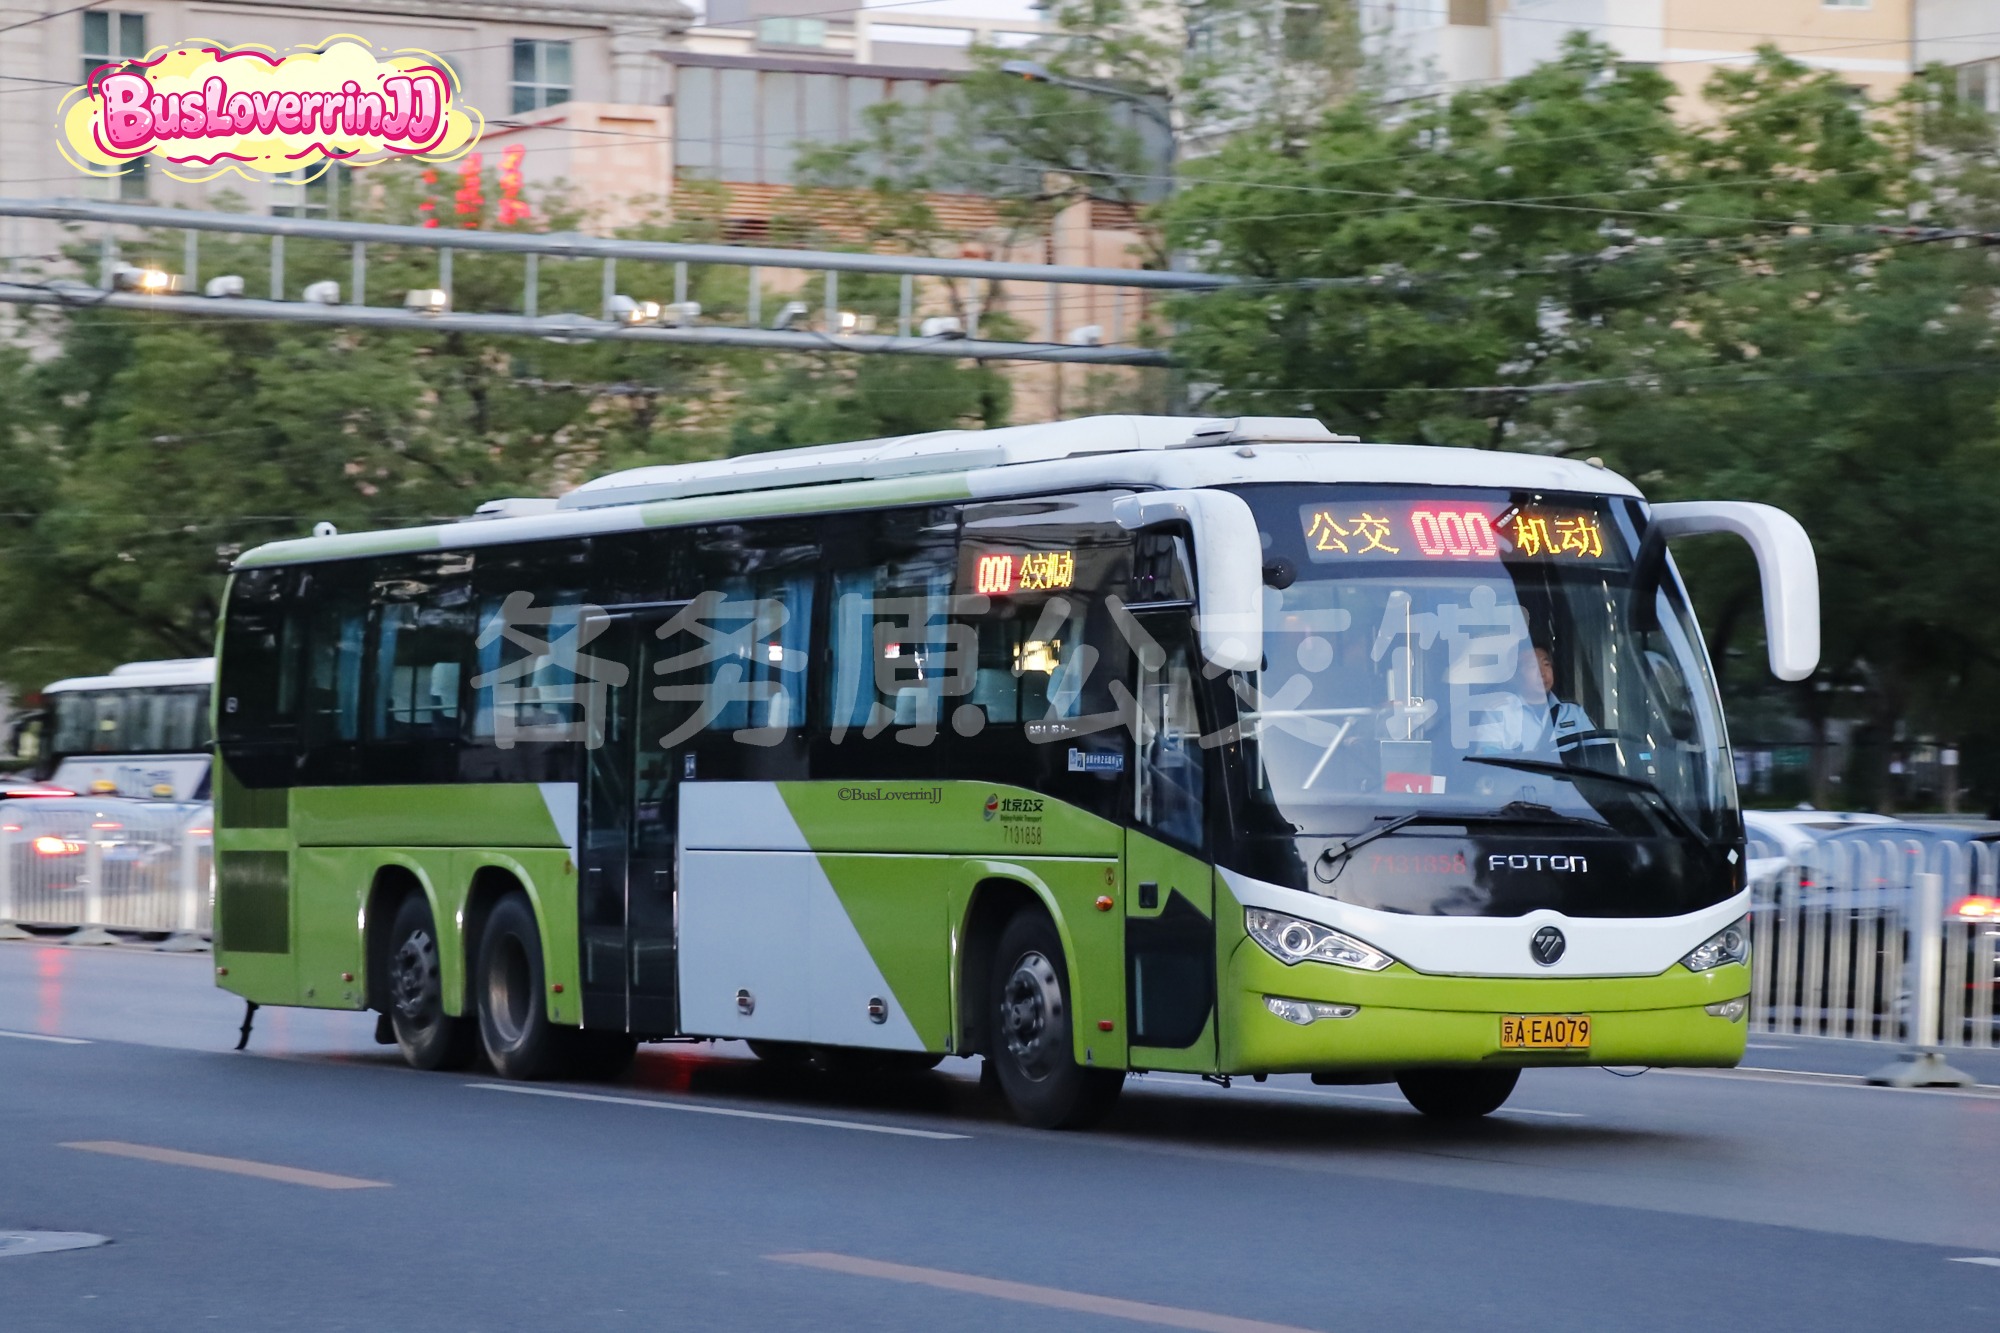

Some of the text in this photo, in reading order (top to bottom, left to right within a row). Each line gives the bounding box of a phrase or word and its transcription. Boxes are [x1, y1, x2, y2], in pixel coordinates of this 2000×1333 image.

[1307, 511, 1603, 558] 公交 000 机动
[979, 550, 1073, 593] 000 公交机动
[1001, 798, 1044, 812] 北京公交
[1003, 825, 1041, 845] 7131858
[1370, 853, 1467, 875] 7131858
[1488, 854, 1588, 873] FOTON
